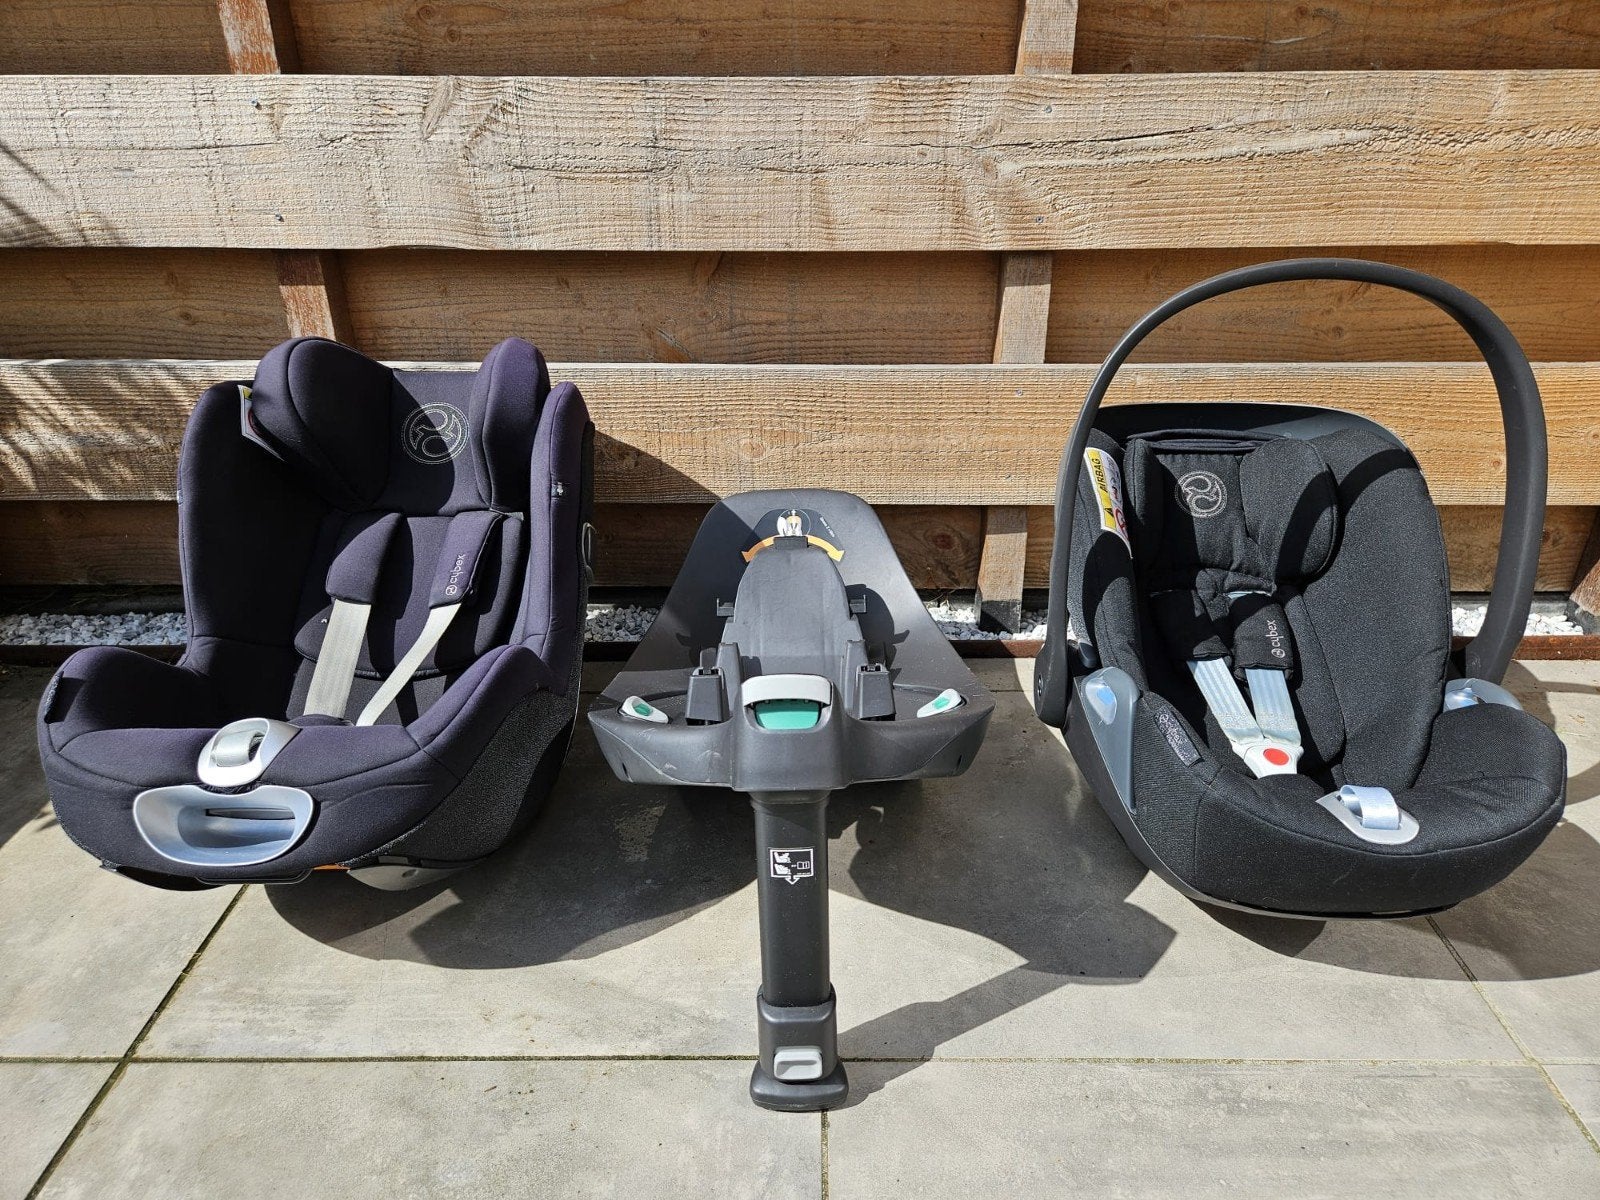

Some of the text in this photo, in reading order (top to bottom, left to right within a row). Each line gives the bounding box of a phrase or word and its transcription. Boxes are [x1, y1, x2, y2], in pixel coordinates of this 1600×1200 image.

[1091, 458, 1108, 493] AIRBAG
[450, 554, 466, 584] cybex
[1265, 620, 1284, 647] cybex
